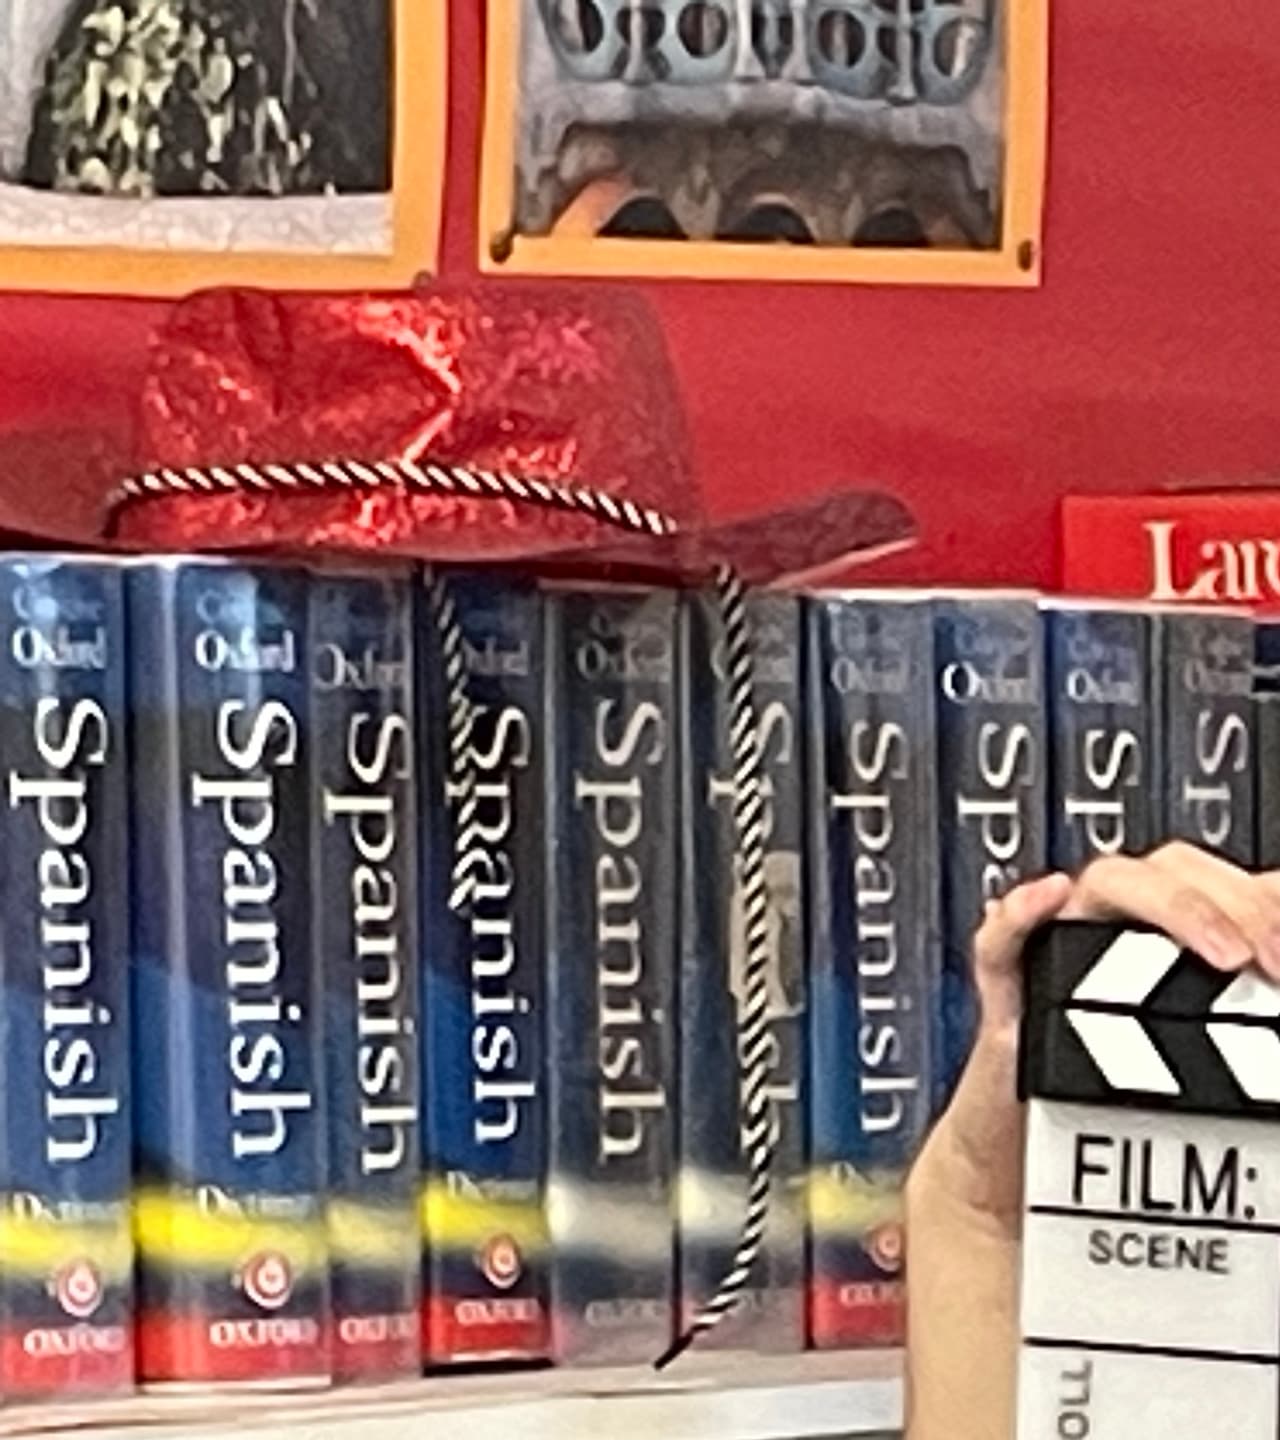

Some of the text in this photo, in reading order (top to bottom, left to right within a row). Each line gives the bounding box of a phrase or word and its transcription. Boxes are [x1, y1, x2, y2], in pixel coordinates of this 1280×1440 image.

[9, 696, 118, 1163] Spanish
[191, 696, 312, 1160] Spanish
[324, 711, 418, 1176] Spanish
[445, 703, 536, 1144] Spanish
[574, 698, 666, 1165] Spanish
[831, 719, 918, 1133] Spanish
[1072, 1132, 1258, 1220] FILM:
[1088, 1229, 1230, 1274] SCENE
